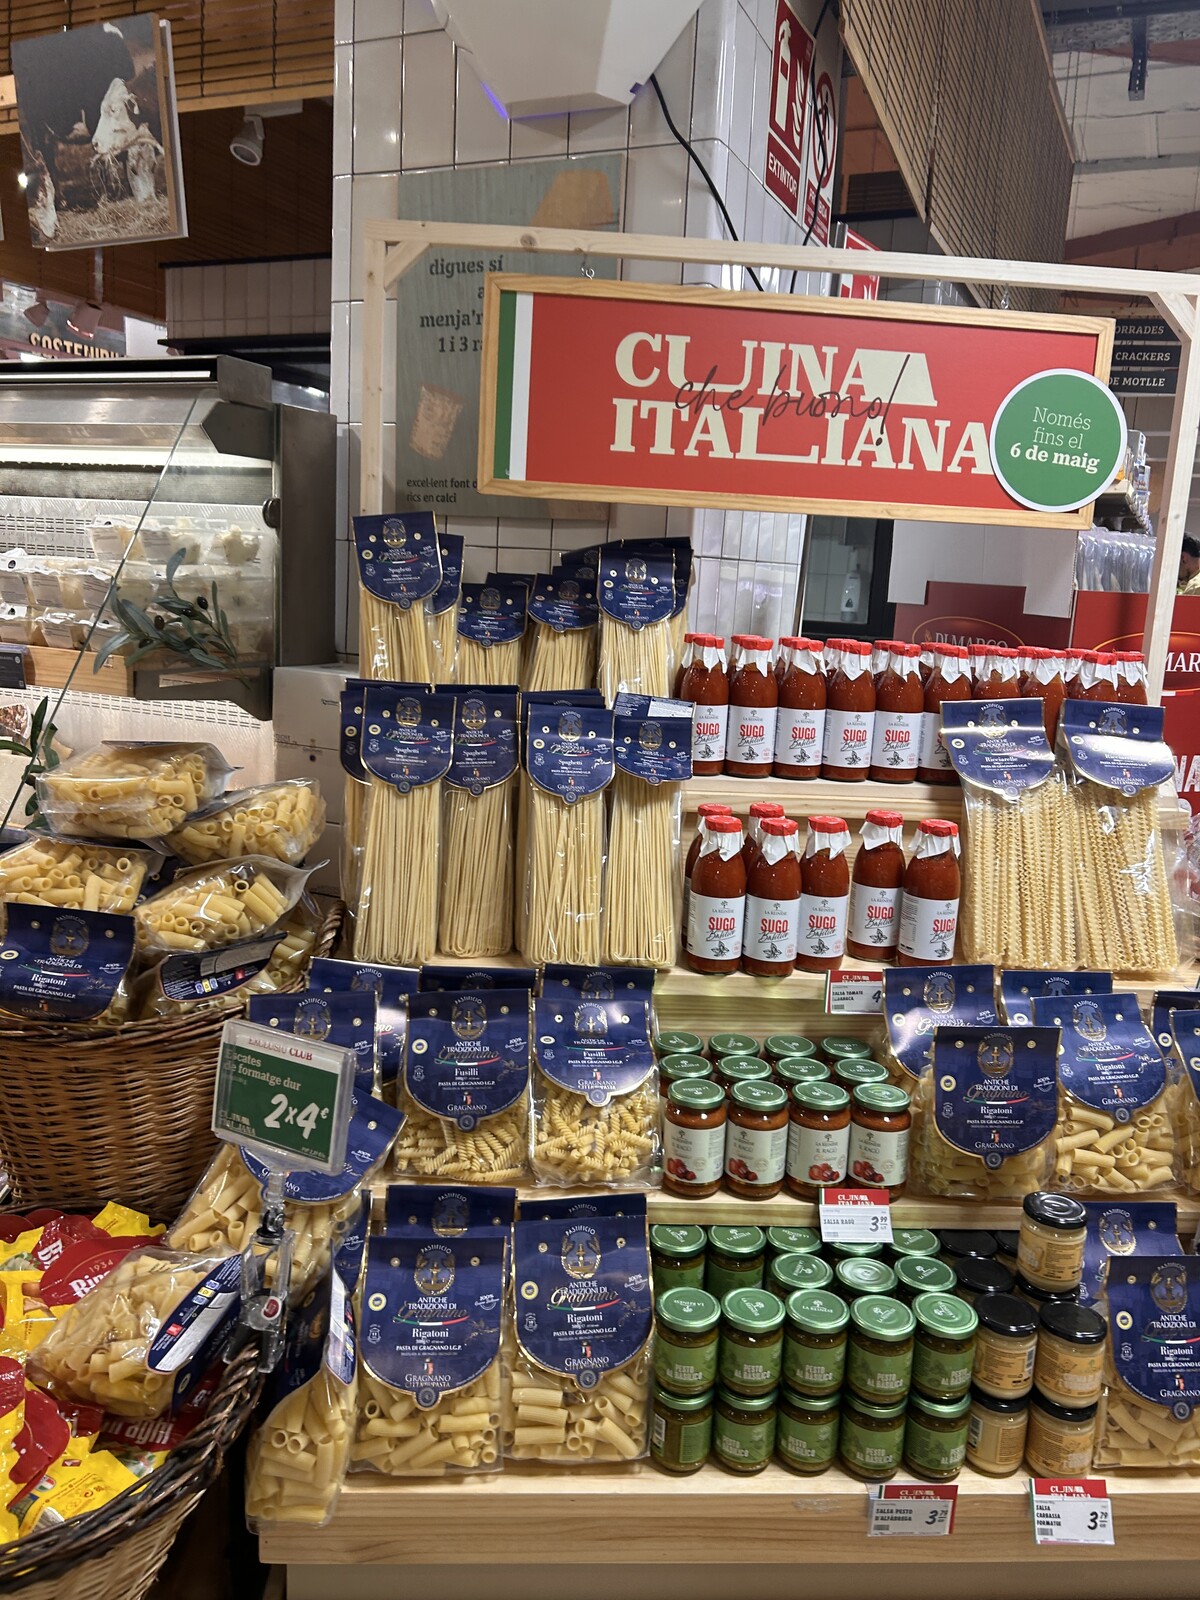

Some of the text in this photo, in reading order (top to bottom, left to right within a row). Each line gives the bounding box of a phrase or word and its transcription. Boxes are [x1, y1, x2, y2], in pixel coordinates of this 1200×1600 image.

[768, 151, 798, 199] EXTINTOR
[429, 254, 504, 279] digues sí
[439, 336, 446, 353] 1
[449, 336, 455, 352] i
[459, 336, 468, 352] 3
[1115, 351, 1171, 362] CRACKERS
[615, 331, 938, 407] CUINA
[1122, 377, 1166, 388] MOTLLE
[675, 353, 911, 447] che buono!
[1032, 406, 1092, 431] Només
[609, 397, 996, 475] ITALIANA
[1033, 427, 1083, 450] fins el
[1010, 442, 1100, 474] 6 de maig
[450, 478, 470, 489] font
[406, 493, 457, 503] rics en calci
[696, 722, 720, 736] SUGO
[740, 724, 765, 738] SUGO
[791, 726, 816, 740] SUGO
[843, 729, 867, 742] SUGO
[885, 729, 910, 743] SUGO
[558, 759, 583, 767] Spaghetti
[867, 905, 894, 920] SUGO
[708, 916, 735, 931] SUGO
[761, 918, 788, 933] SUGO
[808, 914, 836, 929] SUGO
[356, 968, 382, 978] PASTIFICIO
[927, 971, 953, 980] PASTIFICIO
[31, 973, 68, 987] Rigatoni
[35, 988, 63, 996] GRAGNANO
[872, 990, 882, 1003] 4
[298, 998, 328, 1008] PASTIFICIO
[225, 1049, 262, 1068] Escates
[289, 1047, 313, 1061] CLUB
[455, 1068, 478, 1076] Fusilli
[1095, 1062, 1126, 1072] Rigatoni
[238, 1064, 281, 1087] formatge
[283, 1077, 302, 1091] dur
[1101, 1097, 1138, 1105] GRAGNANO
[447, 1104, 487, 1112] GRAGNANO
[980, 1106, 1013, 1117] Rigatoni
[438, 1192, 467, 1202] PASTIFICIO
[565, 1225, 596, 1236] PASTIFICIO
[869, 1216, 879, 1232] 3
[421, 1244, 452, 1254] PASTIFICIO
[89, 1259, 114, 1273] 1934
[561, 1286, 598, 1295] TRADIZIONI
[569, 1280, 598, 1288] ANTICHE
[567, 1312, 603, 1325] Rigatoni
[411, 1328, 449, 1342] Rigatoni
[1160, 1345, 1193, 1357] Rigatoni
[565, 1356, 609, 1367] GRAGNANO
[675, 1364, 694, 1373] PESTO
[743, 1370, 771, 1380] BASILICO
[744, 1364, 763, 1373] PESTO
[405, 1374, 451, 1383] GRAGNANO
[877, 1373, 896, 1381] PESTO
[1160, 1389, 1200, 1398] GRAGNANO
[1050, 1485, 1085, 1493] CUINA
[925, 1510, 939, 1525] 3
[1087, 1511, 1099, 1530] 3
